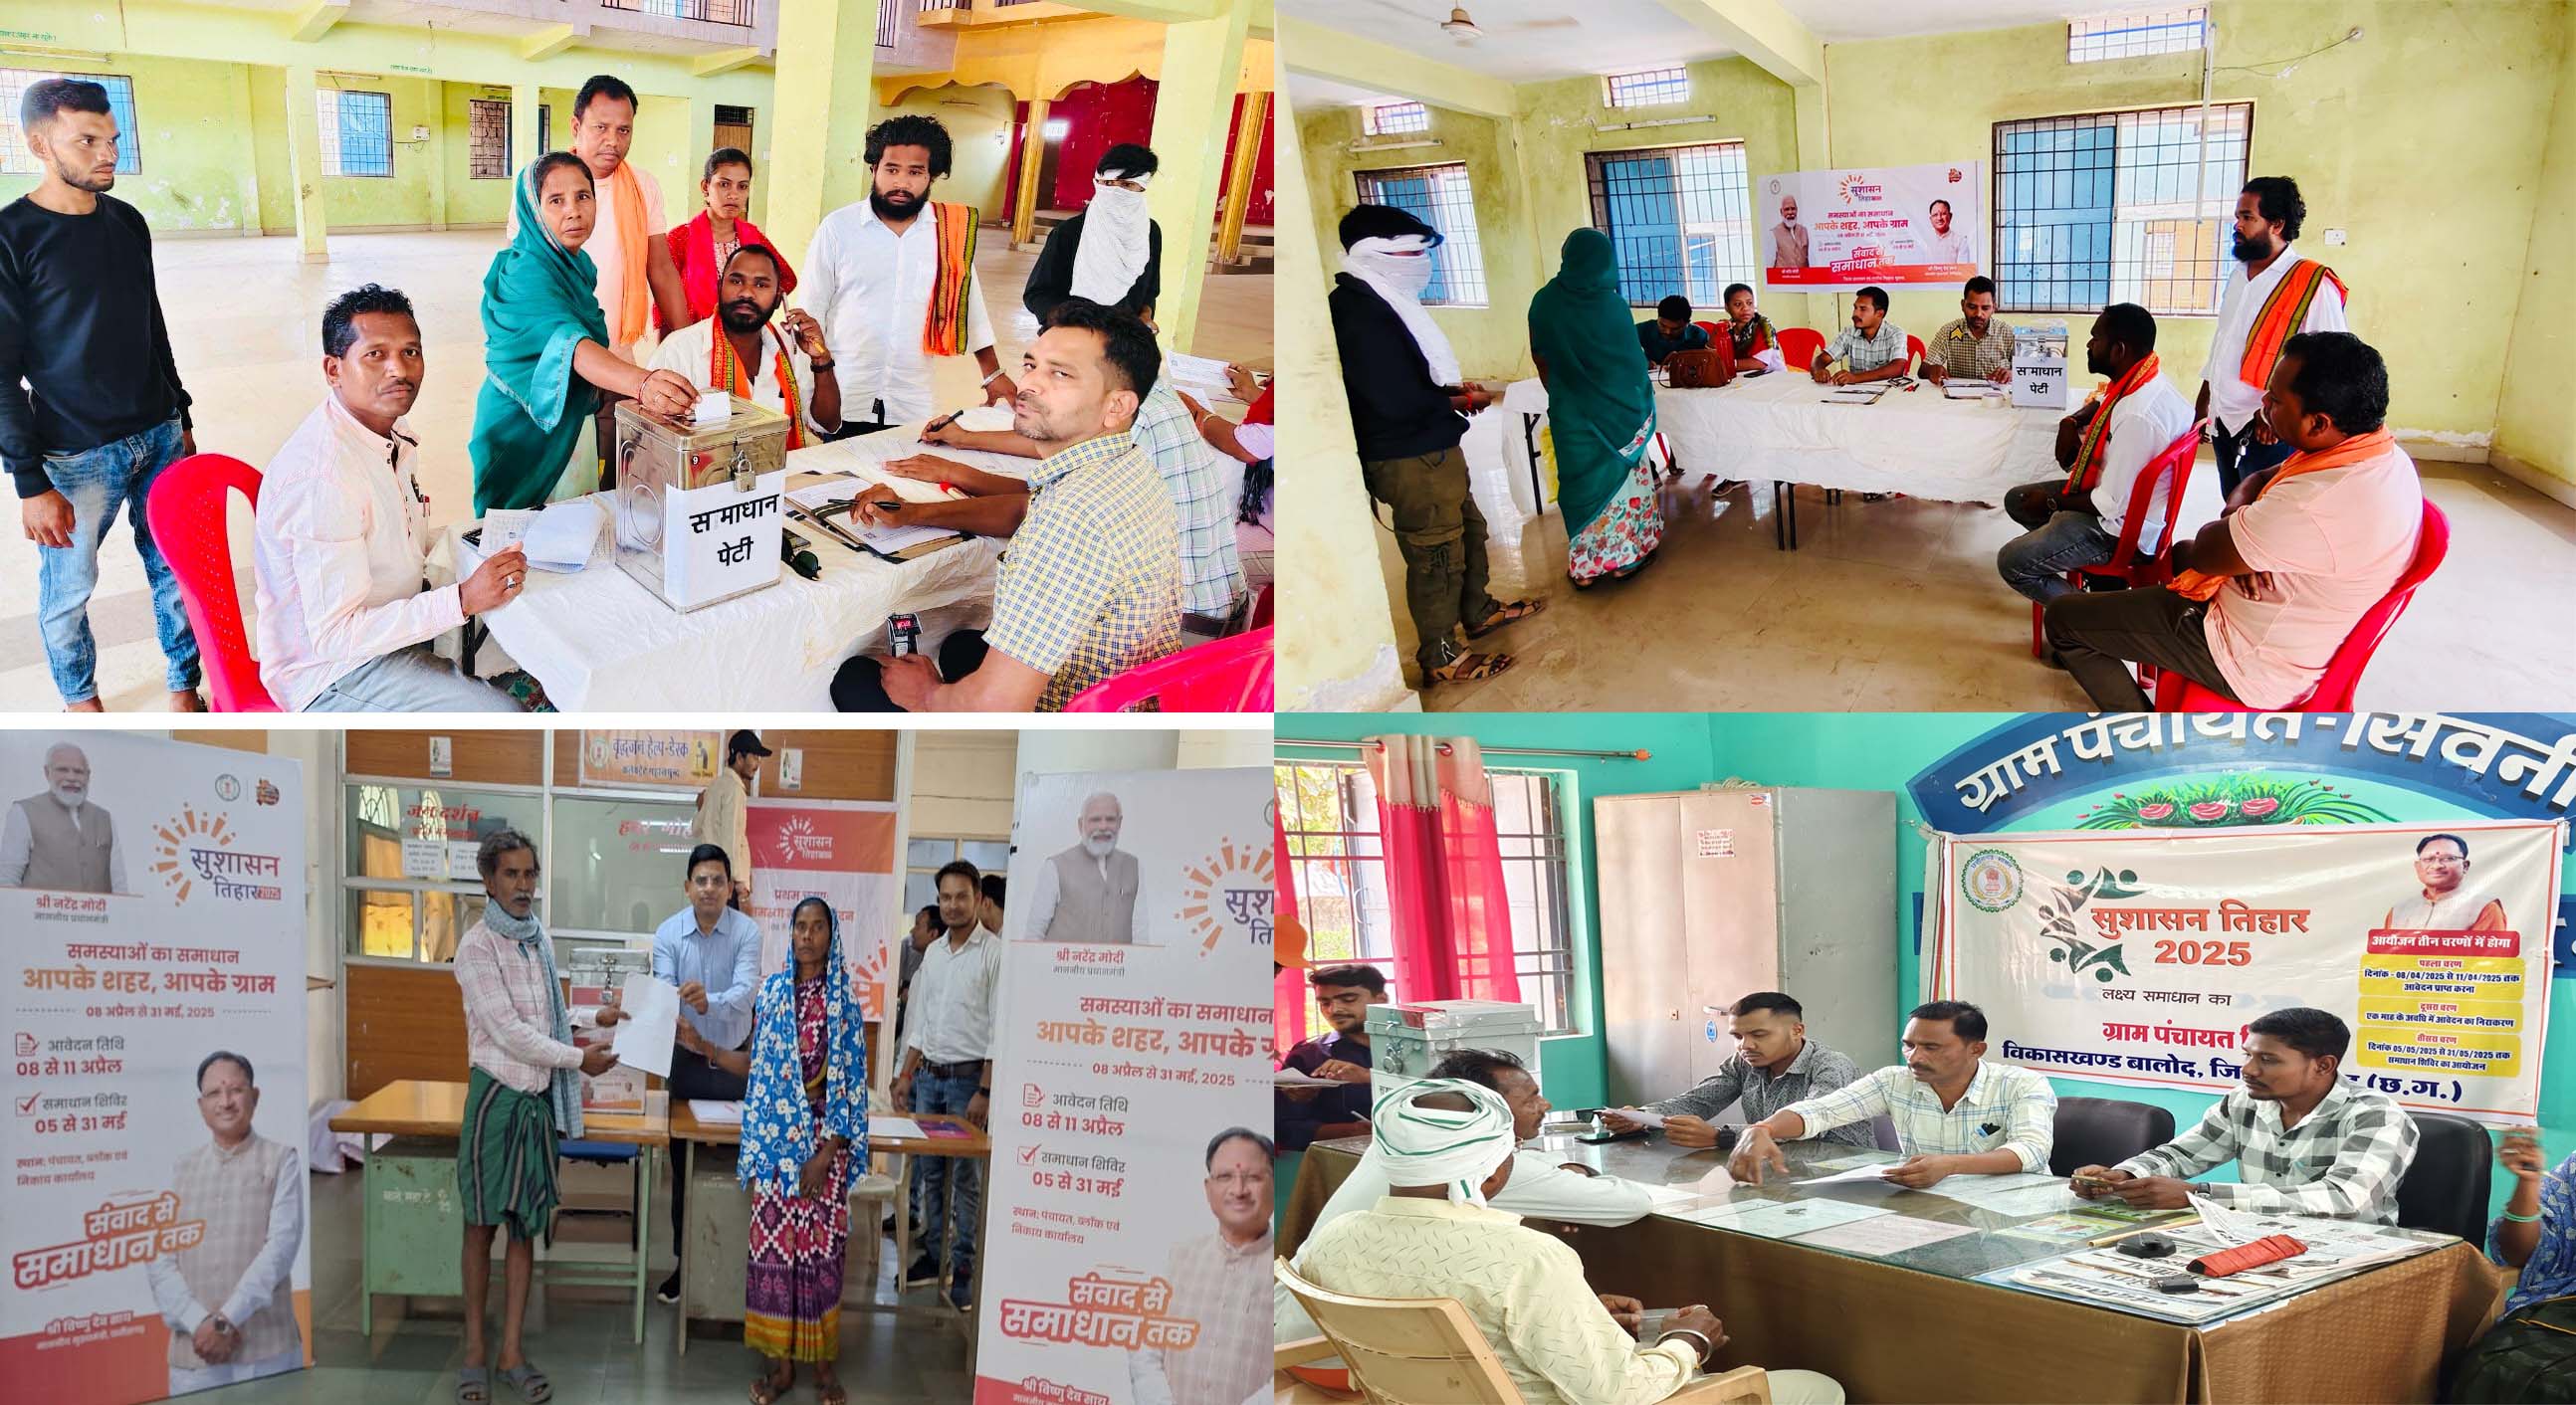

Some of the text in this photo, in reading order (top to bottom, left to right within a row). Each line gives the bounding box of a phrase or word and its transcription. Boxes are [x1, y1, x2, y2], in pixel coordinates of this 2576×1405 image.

[1851, 185, 1881, 196] सुशासन
[1815, 220, 1838, 230] आपके
[1863, 219, 1888, 229] आपके
[1890, 219, 1909, 229] ग्राम
[1831, 259, 1876, 273] समाधान
[2016, 367, 2062, 376] समाधान
[2030, 382, 2049, 394] पेटी
[689, 494, 780, 533] समाधान
[717, 535, 754, 566] पेटी
[1955, 734, 2062, 813] ग्राम
[793, 834, 833, 853] सुशासन
[190, 848, 281, 880] सुशासन
[214, 875, 258, 901] तिहार
[2091, 899, 2311, 939] सुशासन तिहार
[2372, 934, 2511, 948] आयोजन तीन चरणों में होगा
[66, 942, 240, 964] समस्याओं का समाधान
[1056, 947, 1125, 964] श्री नरेंद्र मोदी
[2154, 939, 2253, 966] 2025
[24, 964, 277, 994] आपके शहर, आपके ग्राम
[2364, 969, 2390, 978] दिनांक
[2396, 971, 2445, 980] 08/04/2025
[2447, 971, 2454, 980] से
[2456, 973, 2501, 982] 11/04/2025
[2102, 988, 2233, 1006] लक्ष्य समाधान का
[2404, 983, 2433, 992] आवेदन
[2435, 984, 2453, 993] प्राप्त
[86, 1006, 103, 1017] 08
[106, 1003, 135, 1018] अप्रैल
[138, 1005, 148, 1018] से
[150, 1007, 162, 1018] 31
[187, 1007, 215, 1018] 2025
[1080, 996, 1274, 1024] समस्याओं का समाधान
[2396, 1012, 2404, 1021] के
[2406, 1013, 2427, 1023] अवधि
[2436, 1015, 2463, 1025] आवेदन
[2475, 1017, 2514, 1027] निराकरण
[48, 1036, 125, 1052] आवेदन तिथि
[1037, 1018, 1107, 1045] आपके
[1112, 1026, 1170, 1055] शहर,
[1179, 1028, 1256, 1059] आपके
[2102, 1022, 2150, 1043] ग्राम
[2153, 1019, 2235, 1049] पंचायत
[2002, 1040, 2204, 1079] विकासखण्ड बालोद,
[2368, 1042, 2392, 1051] दिनांक
[2393, 1045, 2438, 1055] 05/05/2025
[2439, 1046, 2446, 1055] से
[2447, 1048, 2493, 1059] 31/05/2025
[16, 1055, 122, 1076] 08 से 11 अप्रैल
[1093, 1064, 1108, 1075] 08
[1112, 1062, 1144, 1078] अप्रैल
[1146, 1066, 1157, 1080] से
[1160, 1070, 1173, 1081] 31
[1201, 1074, 1235, 1087] 2025
[2388, 1057, 2416, 1066] समाधान
[2417, 1058, 2439, 1068] शिविर
[2452, 1061, 2485, 1071] आयोजन
[2367, 1074, 2463, 1103] (छ.ग.)
[42, 1093, 127, 1110] समाधान शिविर
[1053, 1093, 1129, 1113] आवेदन तिथि
[35, 1110, 127, 1133] 05 से 31 मई
[1022, 1110, 1124, 1137] 08 से 11 अप्रैल
[1041, 1151, 1127, 1173] समाधान शिविर
[1033, 1170, 1125, 1198] 05 से 31 मई
[88, 1194, 177, 1237] संवाद से
[16, 1222, 203, 1287] समाधान तक
[1071, 1273, 1170, 1311] संवाद से
[1003, 1301, 1194, 1346] समाधान तक
